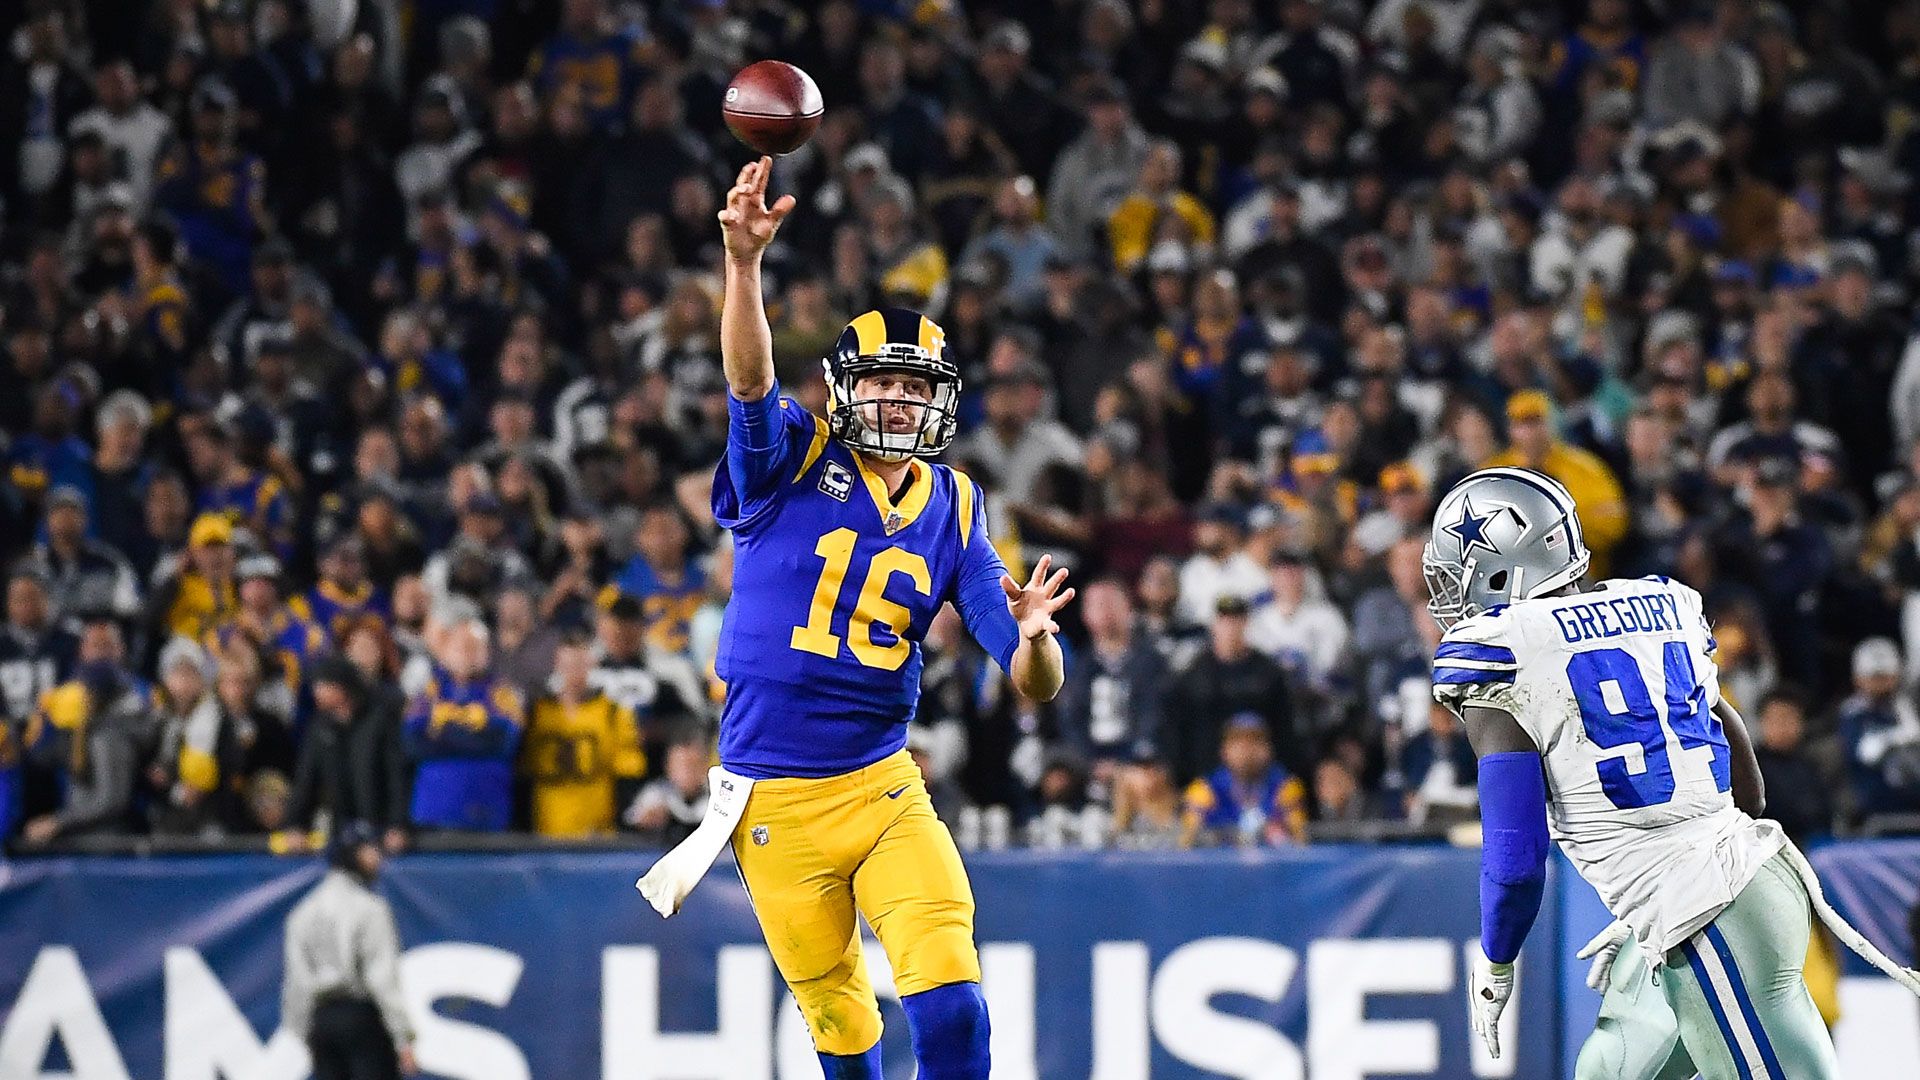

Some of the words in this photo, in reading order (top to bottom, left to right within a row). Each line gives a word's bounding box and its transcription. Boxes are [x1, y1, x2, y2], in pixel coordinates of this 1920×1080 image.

[824, 464, 852, 493] C
[790, 527, 932, 671] 16
[1552, 593, 1683, 643] GREGORY
[1566, 637, 1731, 810] 94
